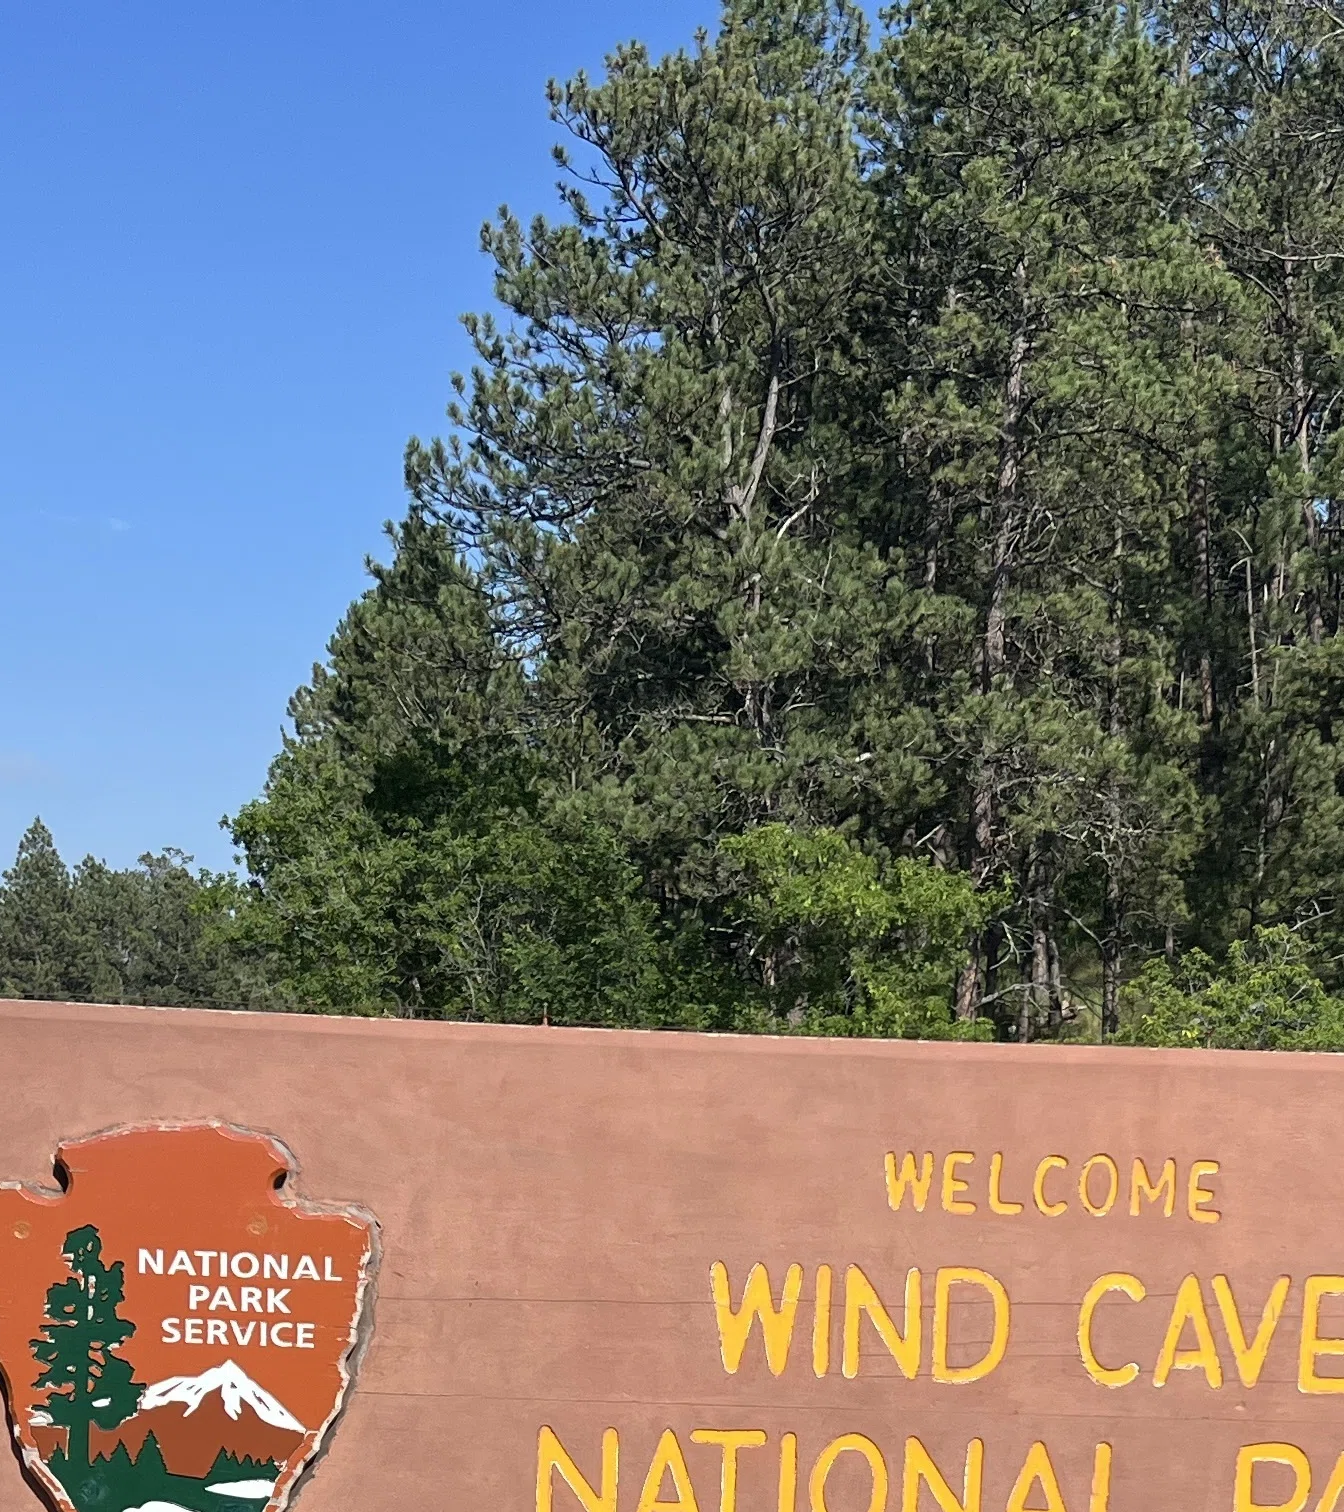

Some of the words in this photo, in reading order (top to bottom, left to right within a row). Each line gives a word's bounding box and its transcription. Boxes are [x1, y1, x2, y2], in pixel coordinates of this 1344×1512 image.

[884, 1151, 1221, 1223] WELCOME
[137, 1248, 343, 1283] NATIONAL
[187, 1284, 292, 1315] PARK
[160, 1318, 316, 1350] SERVICE
[709, 1261, 1011, 1386] WIND
